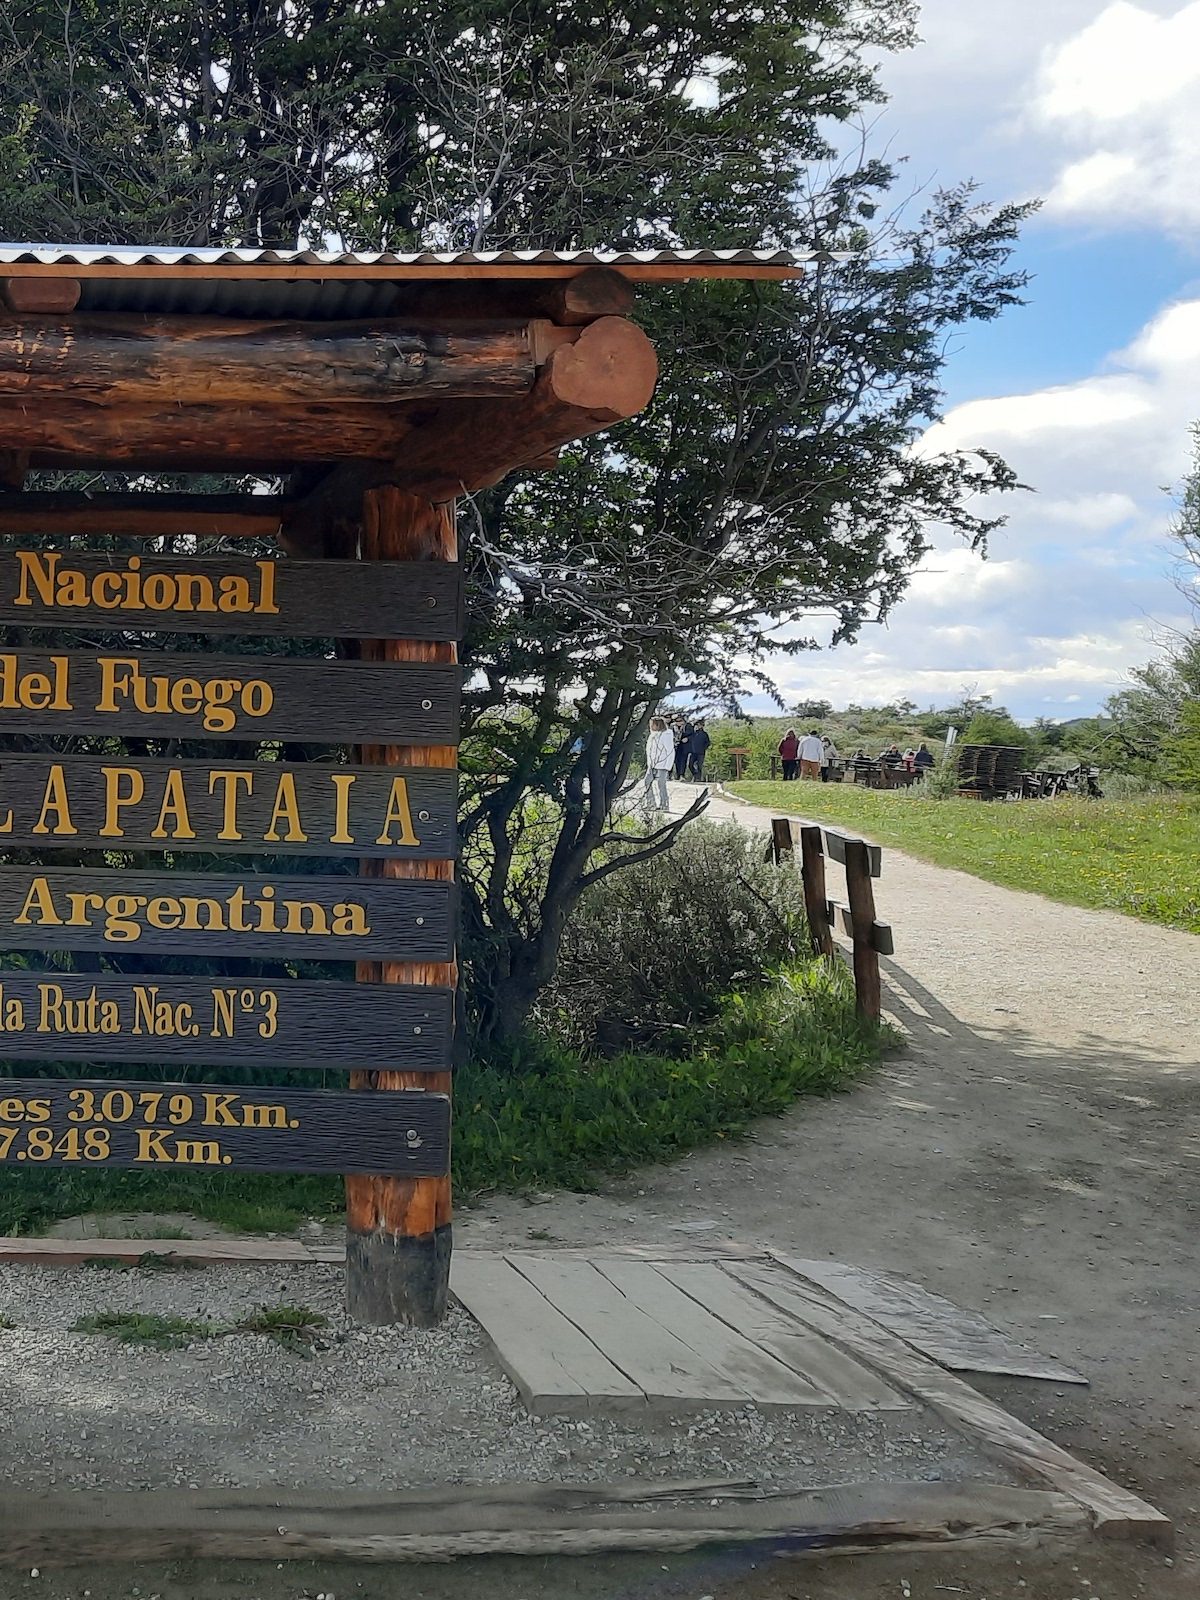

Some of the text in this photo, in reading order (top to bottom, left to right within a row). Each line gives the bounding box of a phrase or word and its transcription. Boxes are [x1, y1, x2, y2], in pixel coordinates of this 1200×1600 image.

[13, 551, 280, 614] Nacional
[94, 657, 274, 732] Fuego
[14, 877, 371, 941] Argentina
[36, 983, 121, 1034] Ruta
[132, 986, 200, 1036] Nac.
[68, 1089, 193, 1125] 3.079
[202, 1093, 300, 1128] Km.
[134, 1128, 232, 1165] Km.
